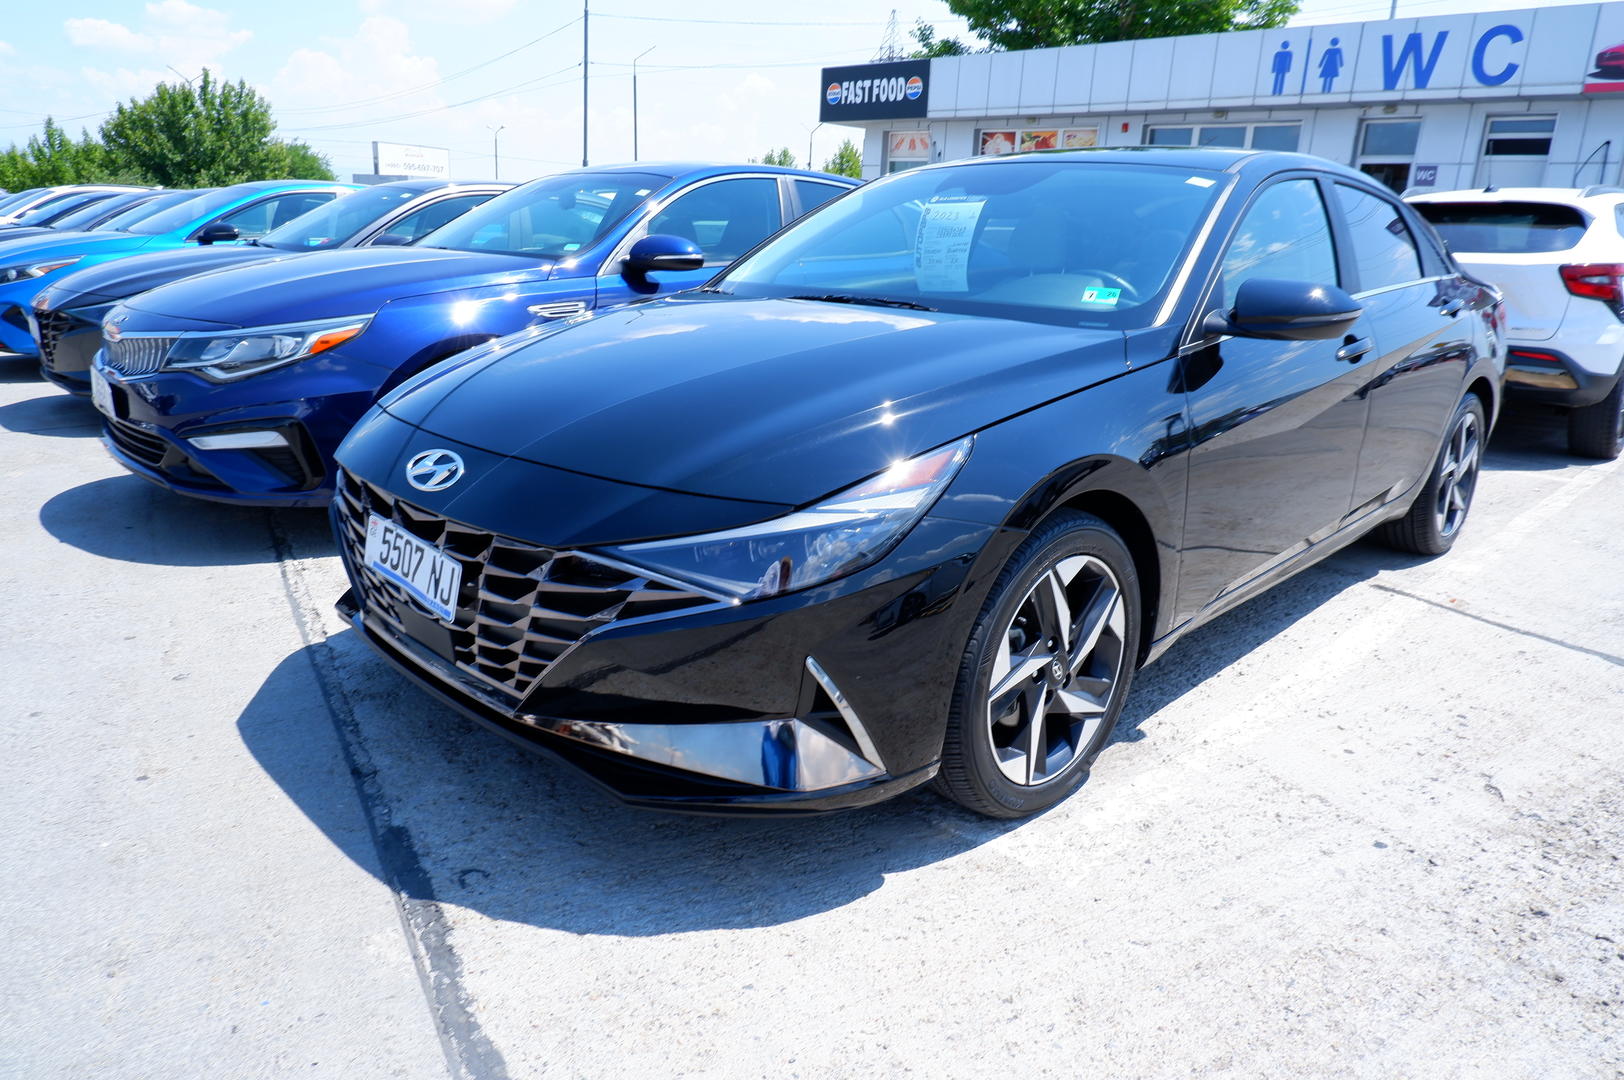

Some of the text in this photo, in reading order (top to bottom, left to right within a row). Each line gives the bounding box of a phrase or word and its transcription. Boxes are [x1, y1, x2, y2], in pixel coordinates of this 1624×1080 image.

[842, 77, 905, 104] FAST FOOD
[1416, 170, 1435, 181] WC
[379, 525, 455, 606] 5507 NJ
